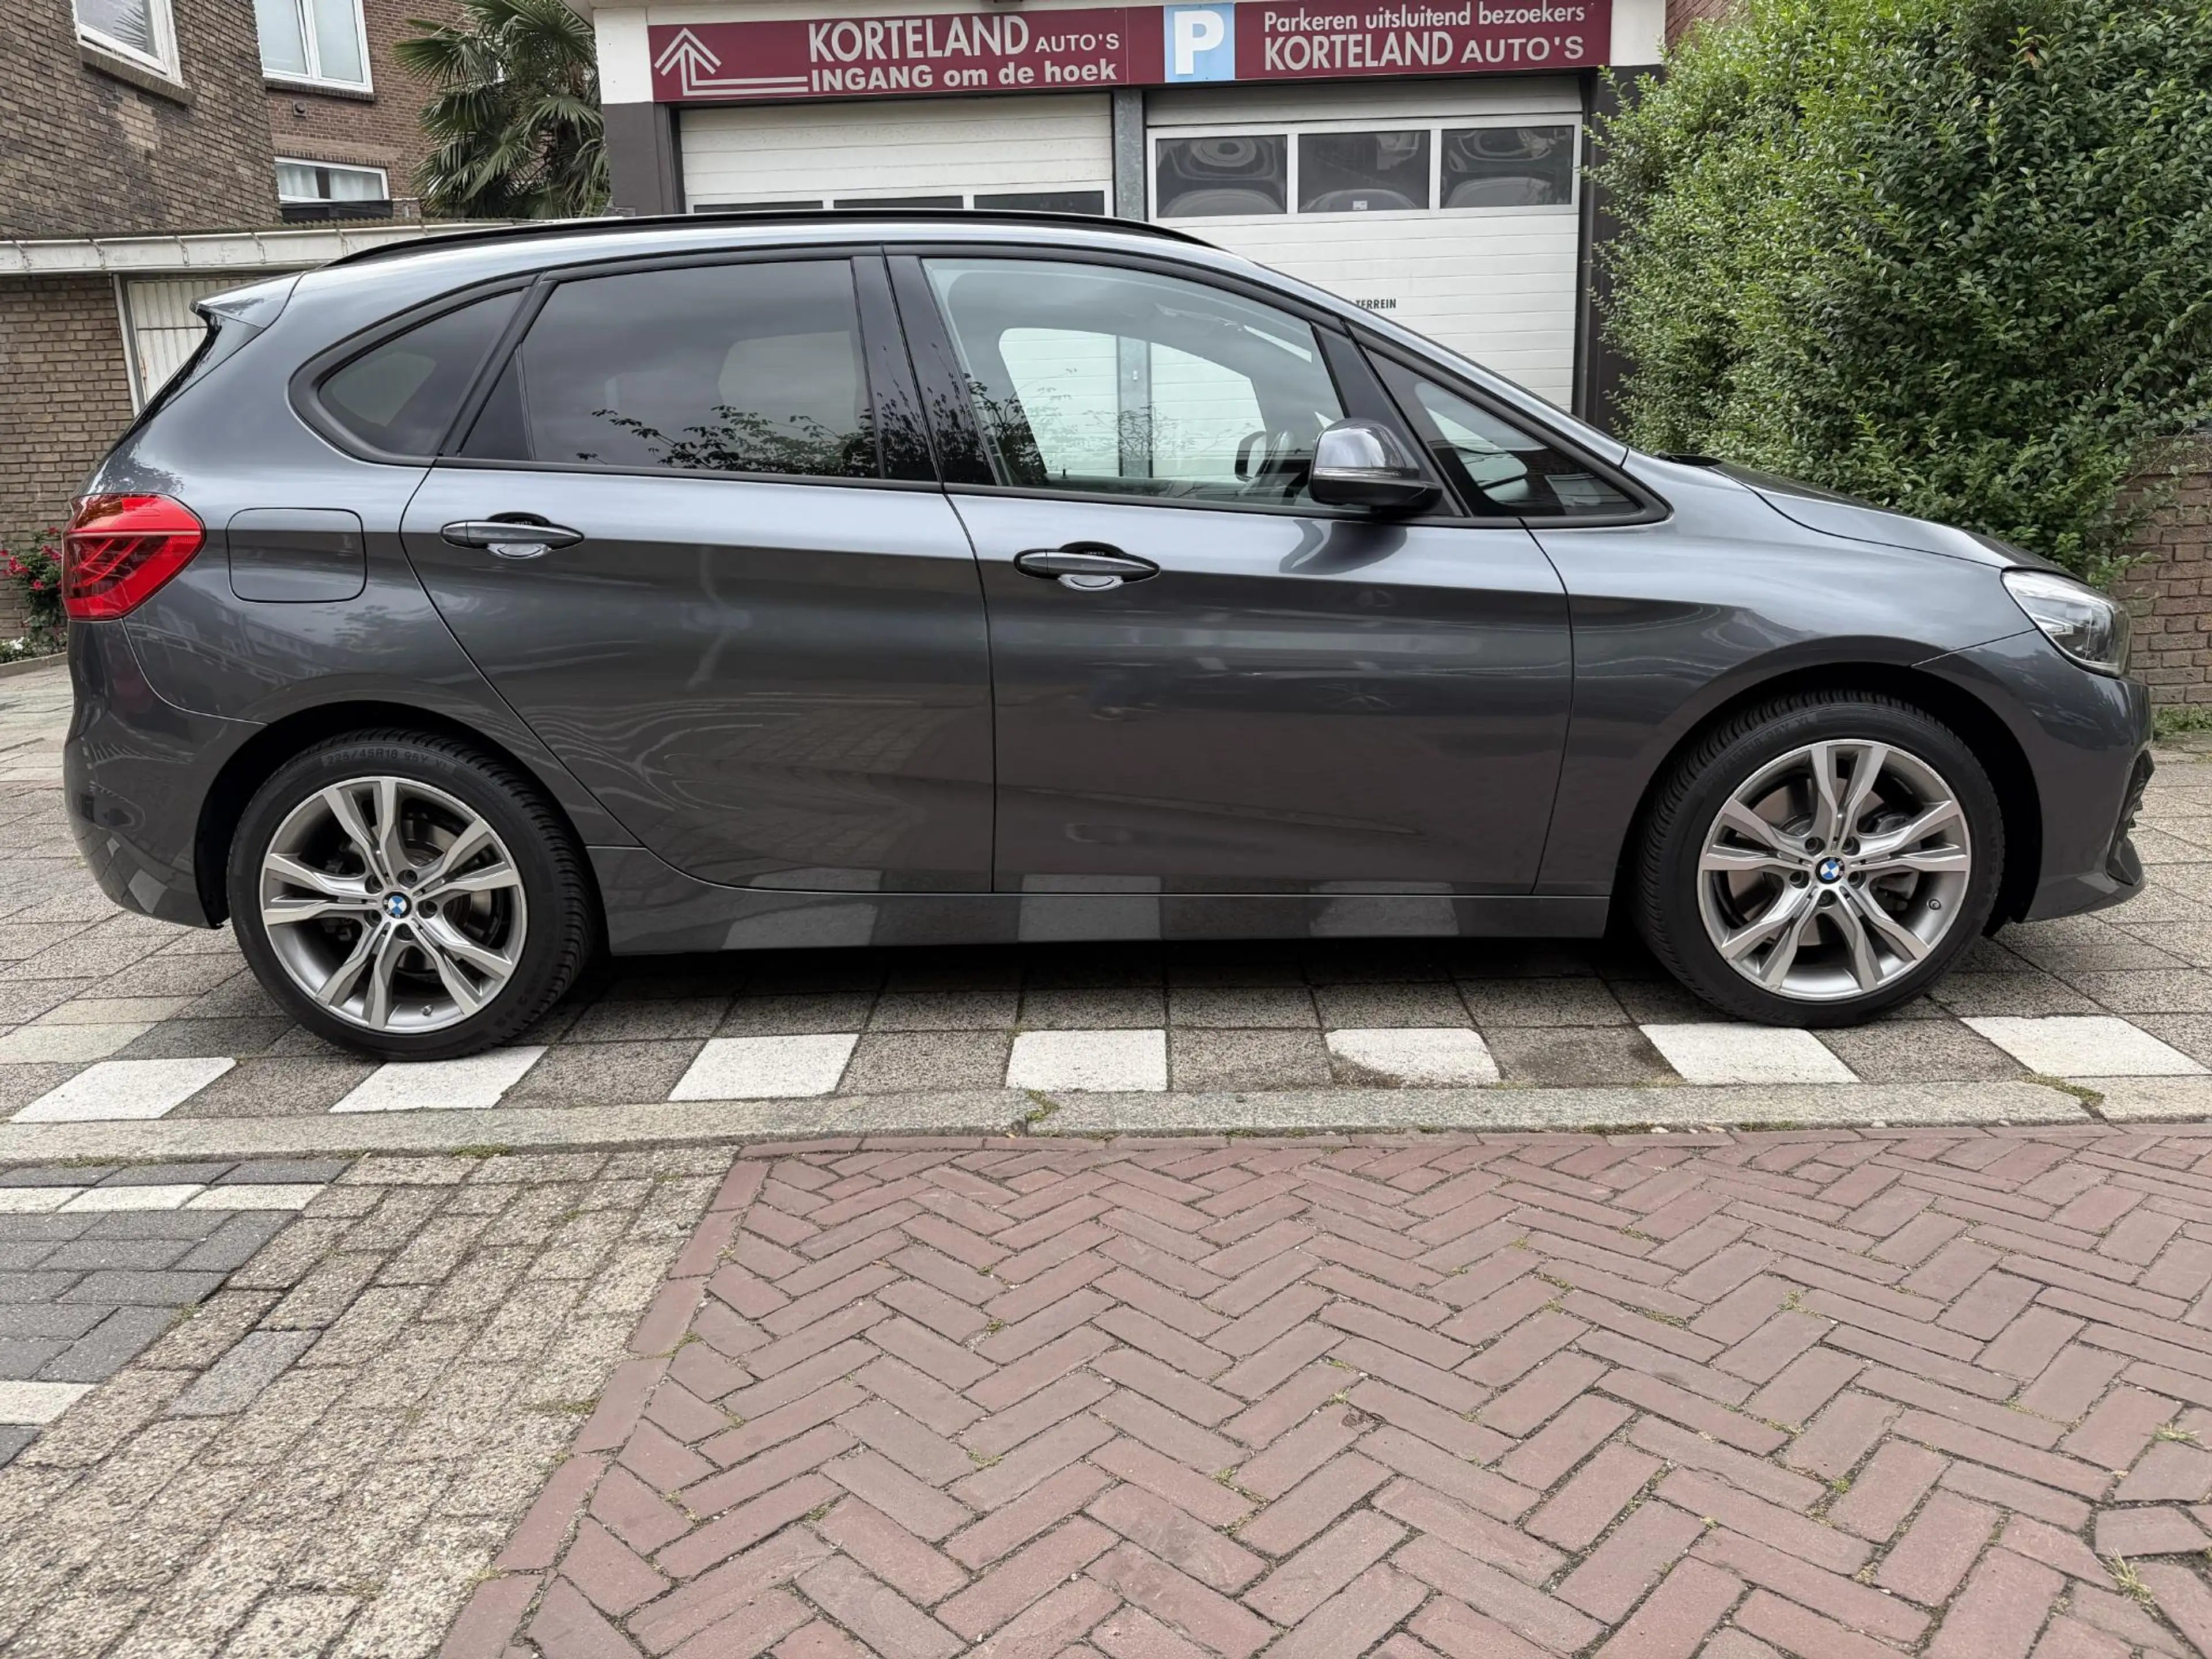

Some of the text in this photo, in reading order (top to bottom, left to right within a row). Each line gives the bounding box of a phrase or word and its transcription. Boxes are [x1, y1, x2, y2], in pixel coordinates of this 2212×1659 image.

[1264, 0, 1585, 33] Parkeren uitsluitend bezoekers
[808, 15, 1120, 63] KORTELAND AUTO'S
[1174, 10, 1225, 75] P
[1264, 31, 1584, 71] KORTELAND AUTO'S
[811, 58, 1118, 92] INGANG om de hoek
[1355, 298, 1396, 309] TERREIN
